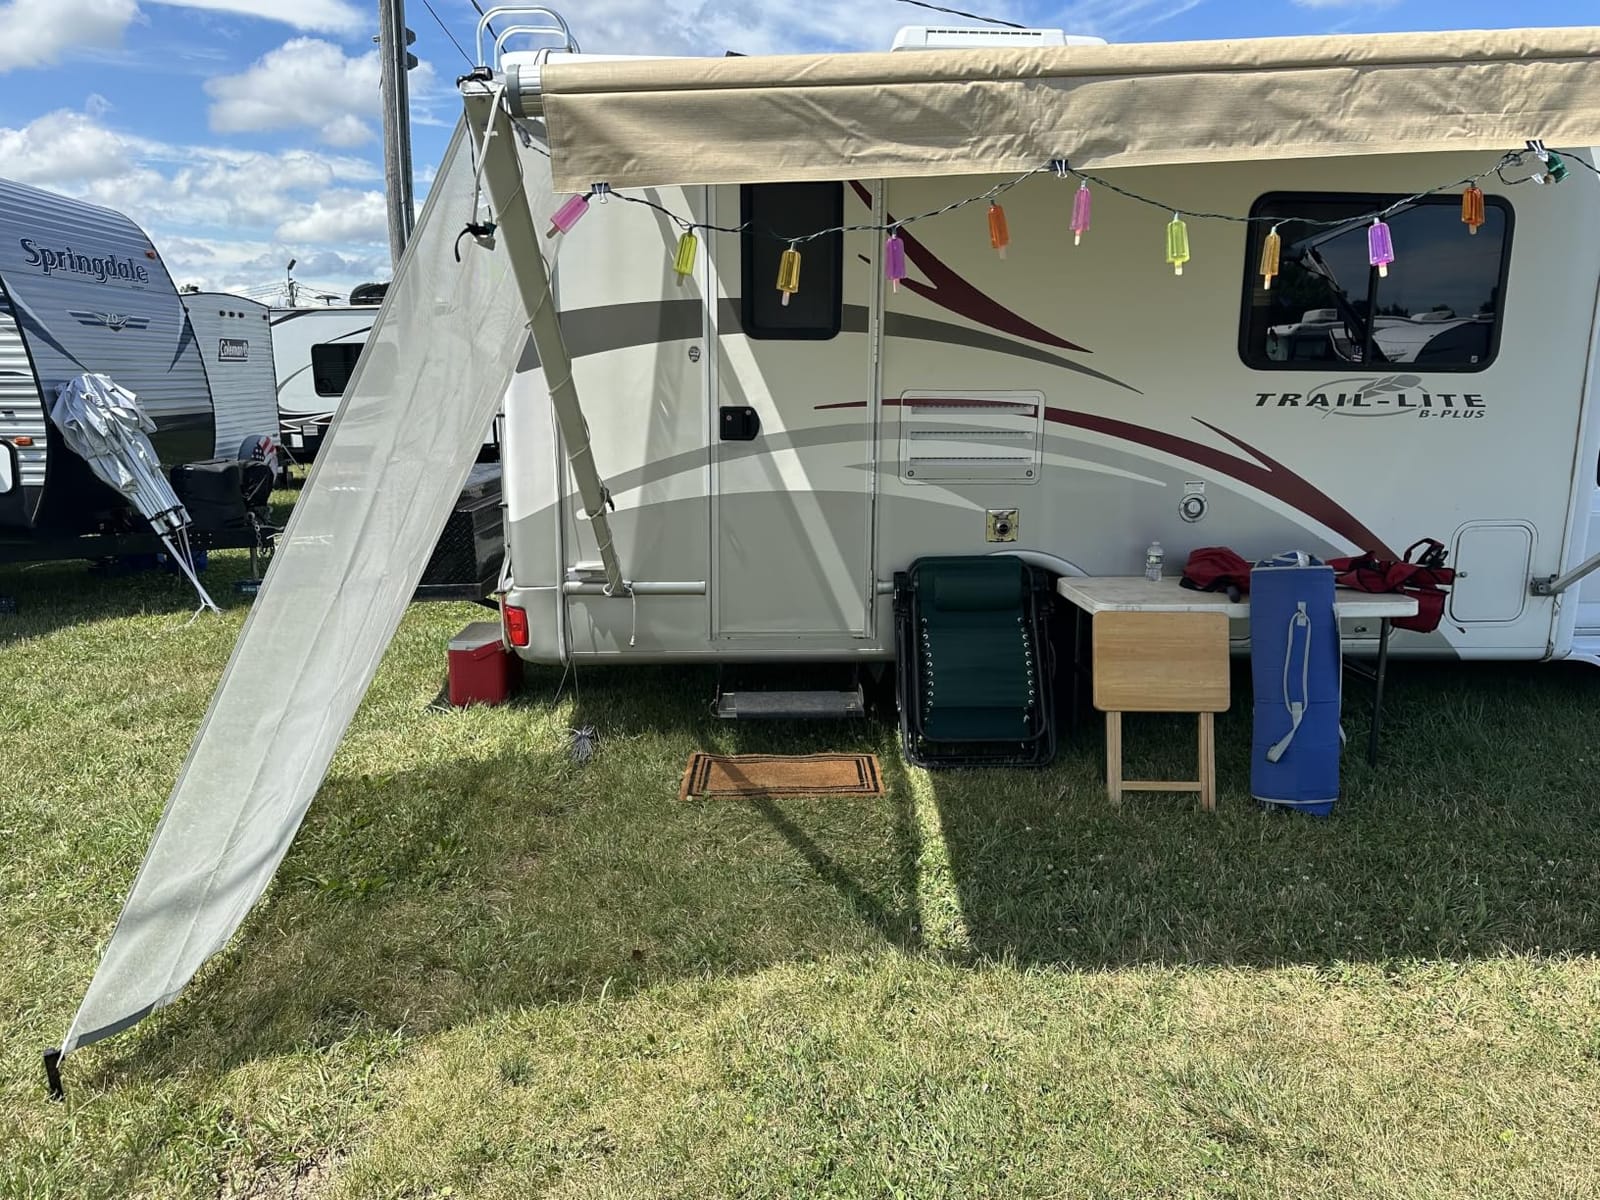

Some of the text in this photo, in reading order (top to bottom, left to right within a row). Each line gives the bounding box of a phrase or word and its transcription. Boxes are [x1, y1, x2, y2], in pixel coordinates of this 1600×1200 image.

[20, 237, 149, 284] Springdale
[1255, 393, 1486, 408] TRAIL-LITE
[1418, 409, 1486, 419] B-PLUS
